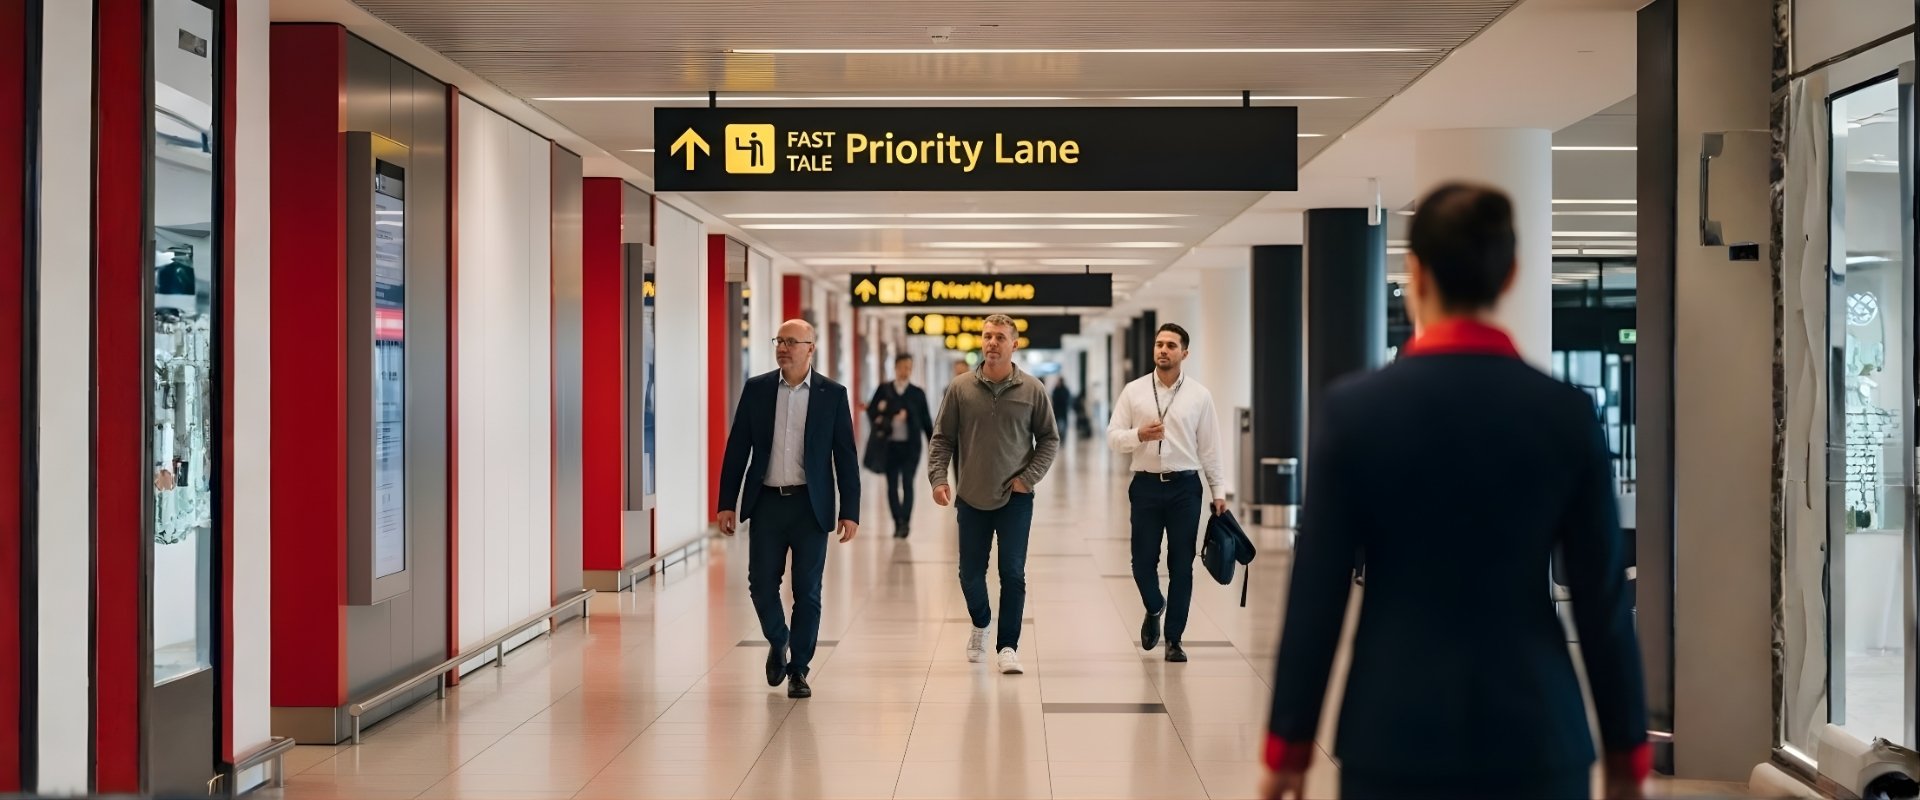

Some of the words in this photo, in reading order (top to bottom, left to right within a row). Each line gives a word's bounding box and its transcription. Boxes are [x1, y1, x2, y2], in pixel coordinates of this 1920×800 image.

[787, 131, 836, 148] FAST
[846, 132, 984, 173] Priority
[995, 132, 1080, 164] Lane
[786, 154, 833, 172] TALE
